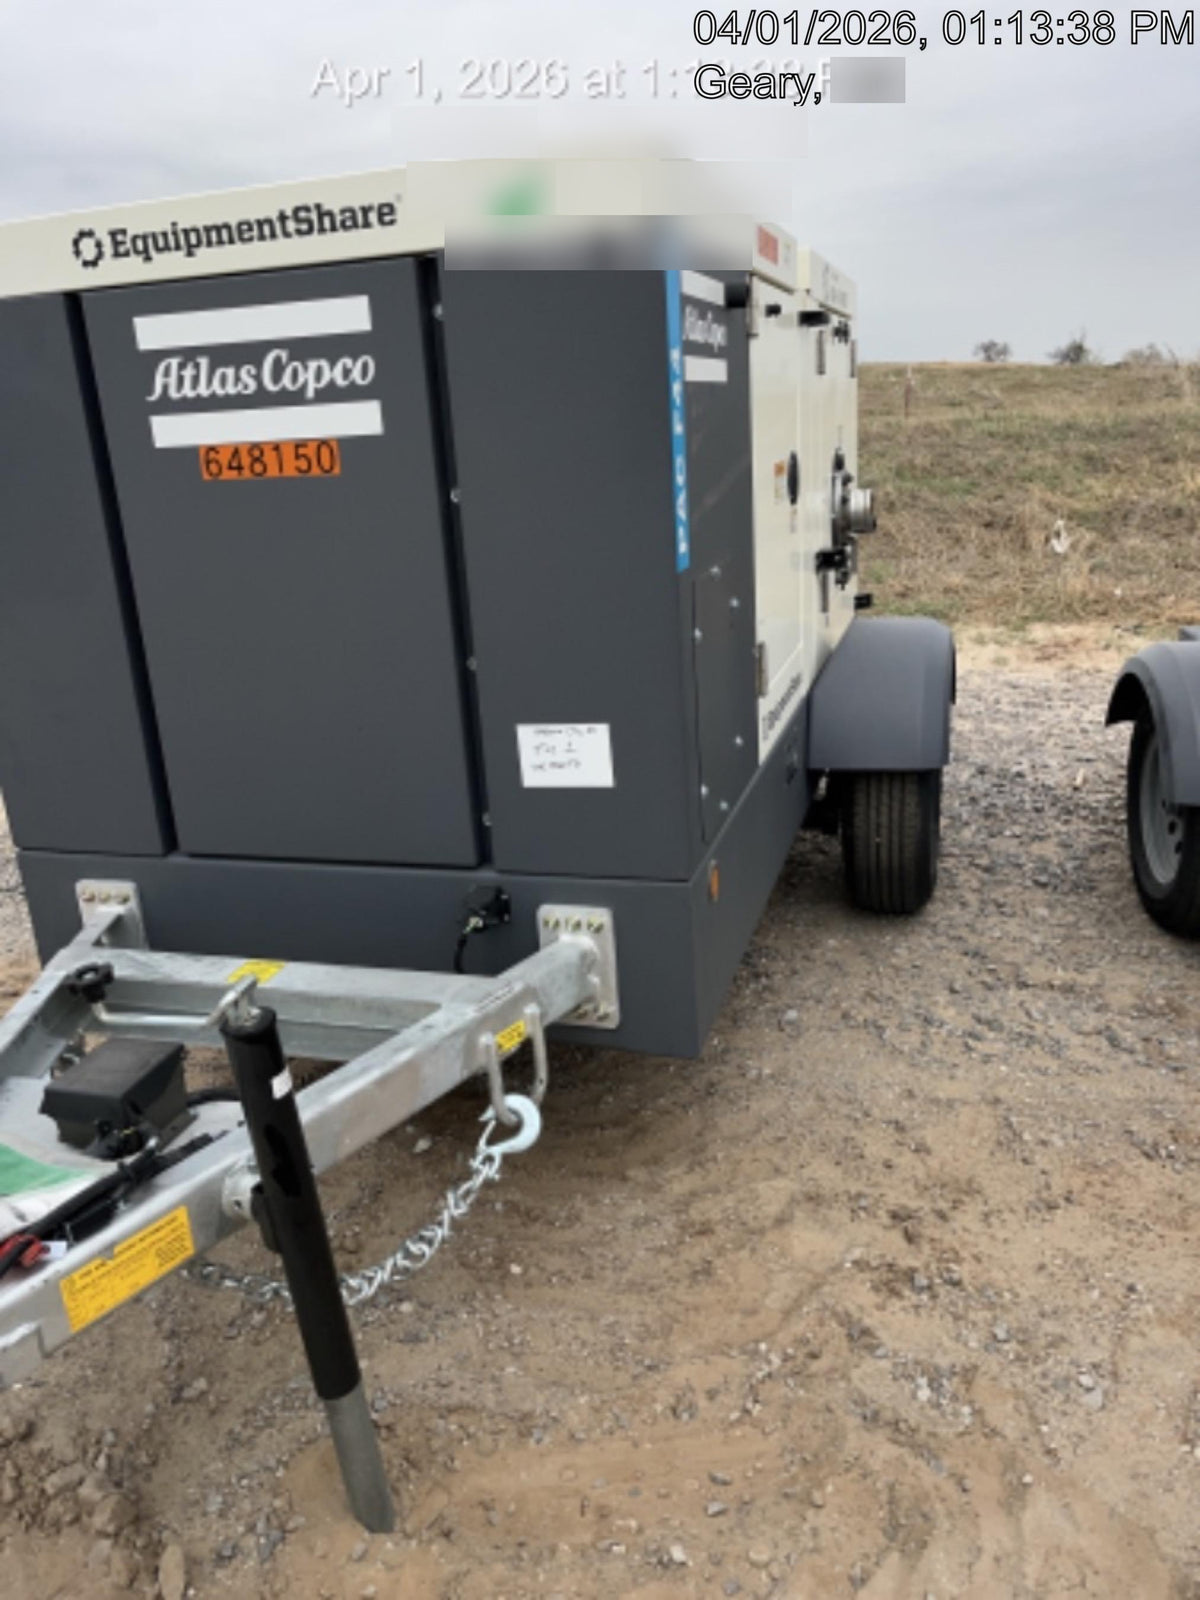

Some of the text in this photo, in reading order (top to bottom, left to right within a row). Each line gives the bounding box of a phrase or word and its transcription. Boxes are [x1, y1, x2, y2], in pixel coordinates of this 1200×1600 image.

[107, 201, 397, 263] EquipmentShare
[147, 348, 376, 401] Atlas Copco
[204, 441, 336, 478] 648150
